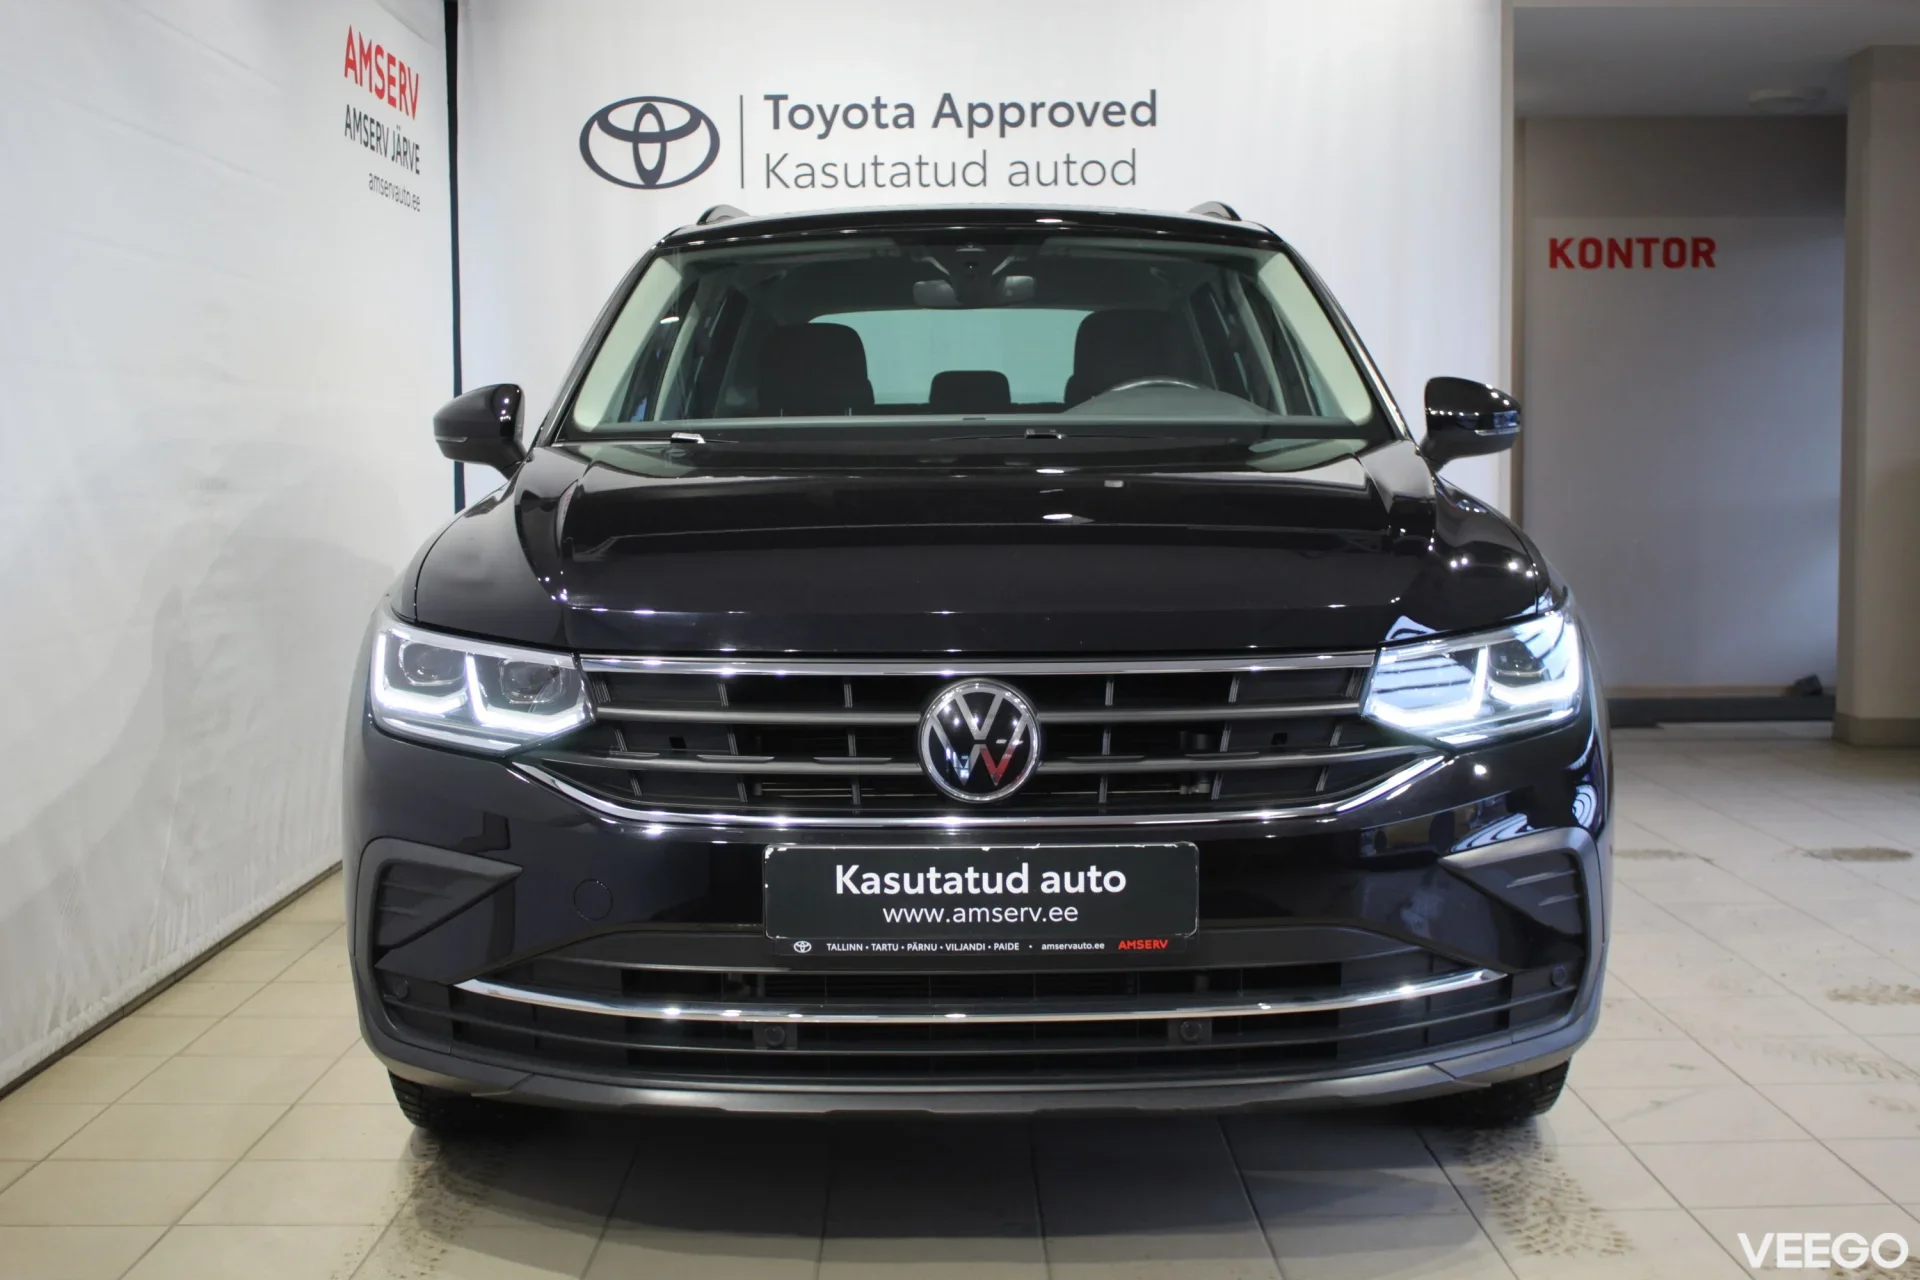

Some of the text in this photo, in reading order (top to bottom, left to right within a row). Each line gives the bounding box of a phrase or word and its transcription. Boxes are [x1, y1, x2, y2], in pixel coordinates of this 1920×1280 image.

[344, 24, 419, 121] AMSERV
[763, 89, 1158, 139] Toyota Approved
[344, 104, 420, 175] AMSERV JÄRVE
[764, 148, 1138, 189] Kasutatud autod
[368, 172, 421, 212] amservauto.ee
[1548, 236, 1717, 270] KONTOR
[835, 862, 1127, 895] Kasutatud auto
[882, 903, 1079, 924] www.amserv.ee
[826, 939, 1169, 952] TALLINN TARTU PÄRNU VILJANDI PAIDE amservauto.ee AMSERV
